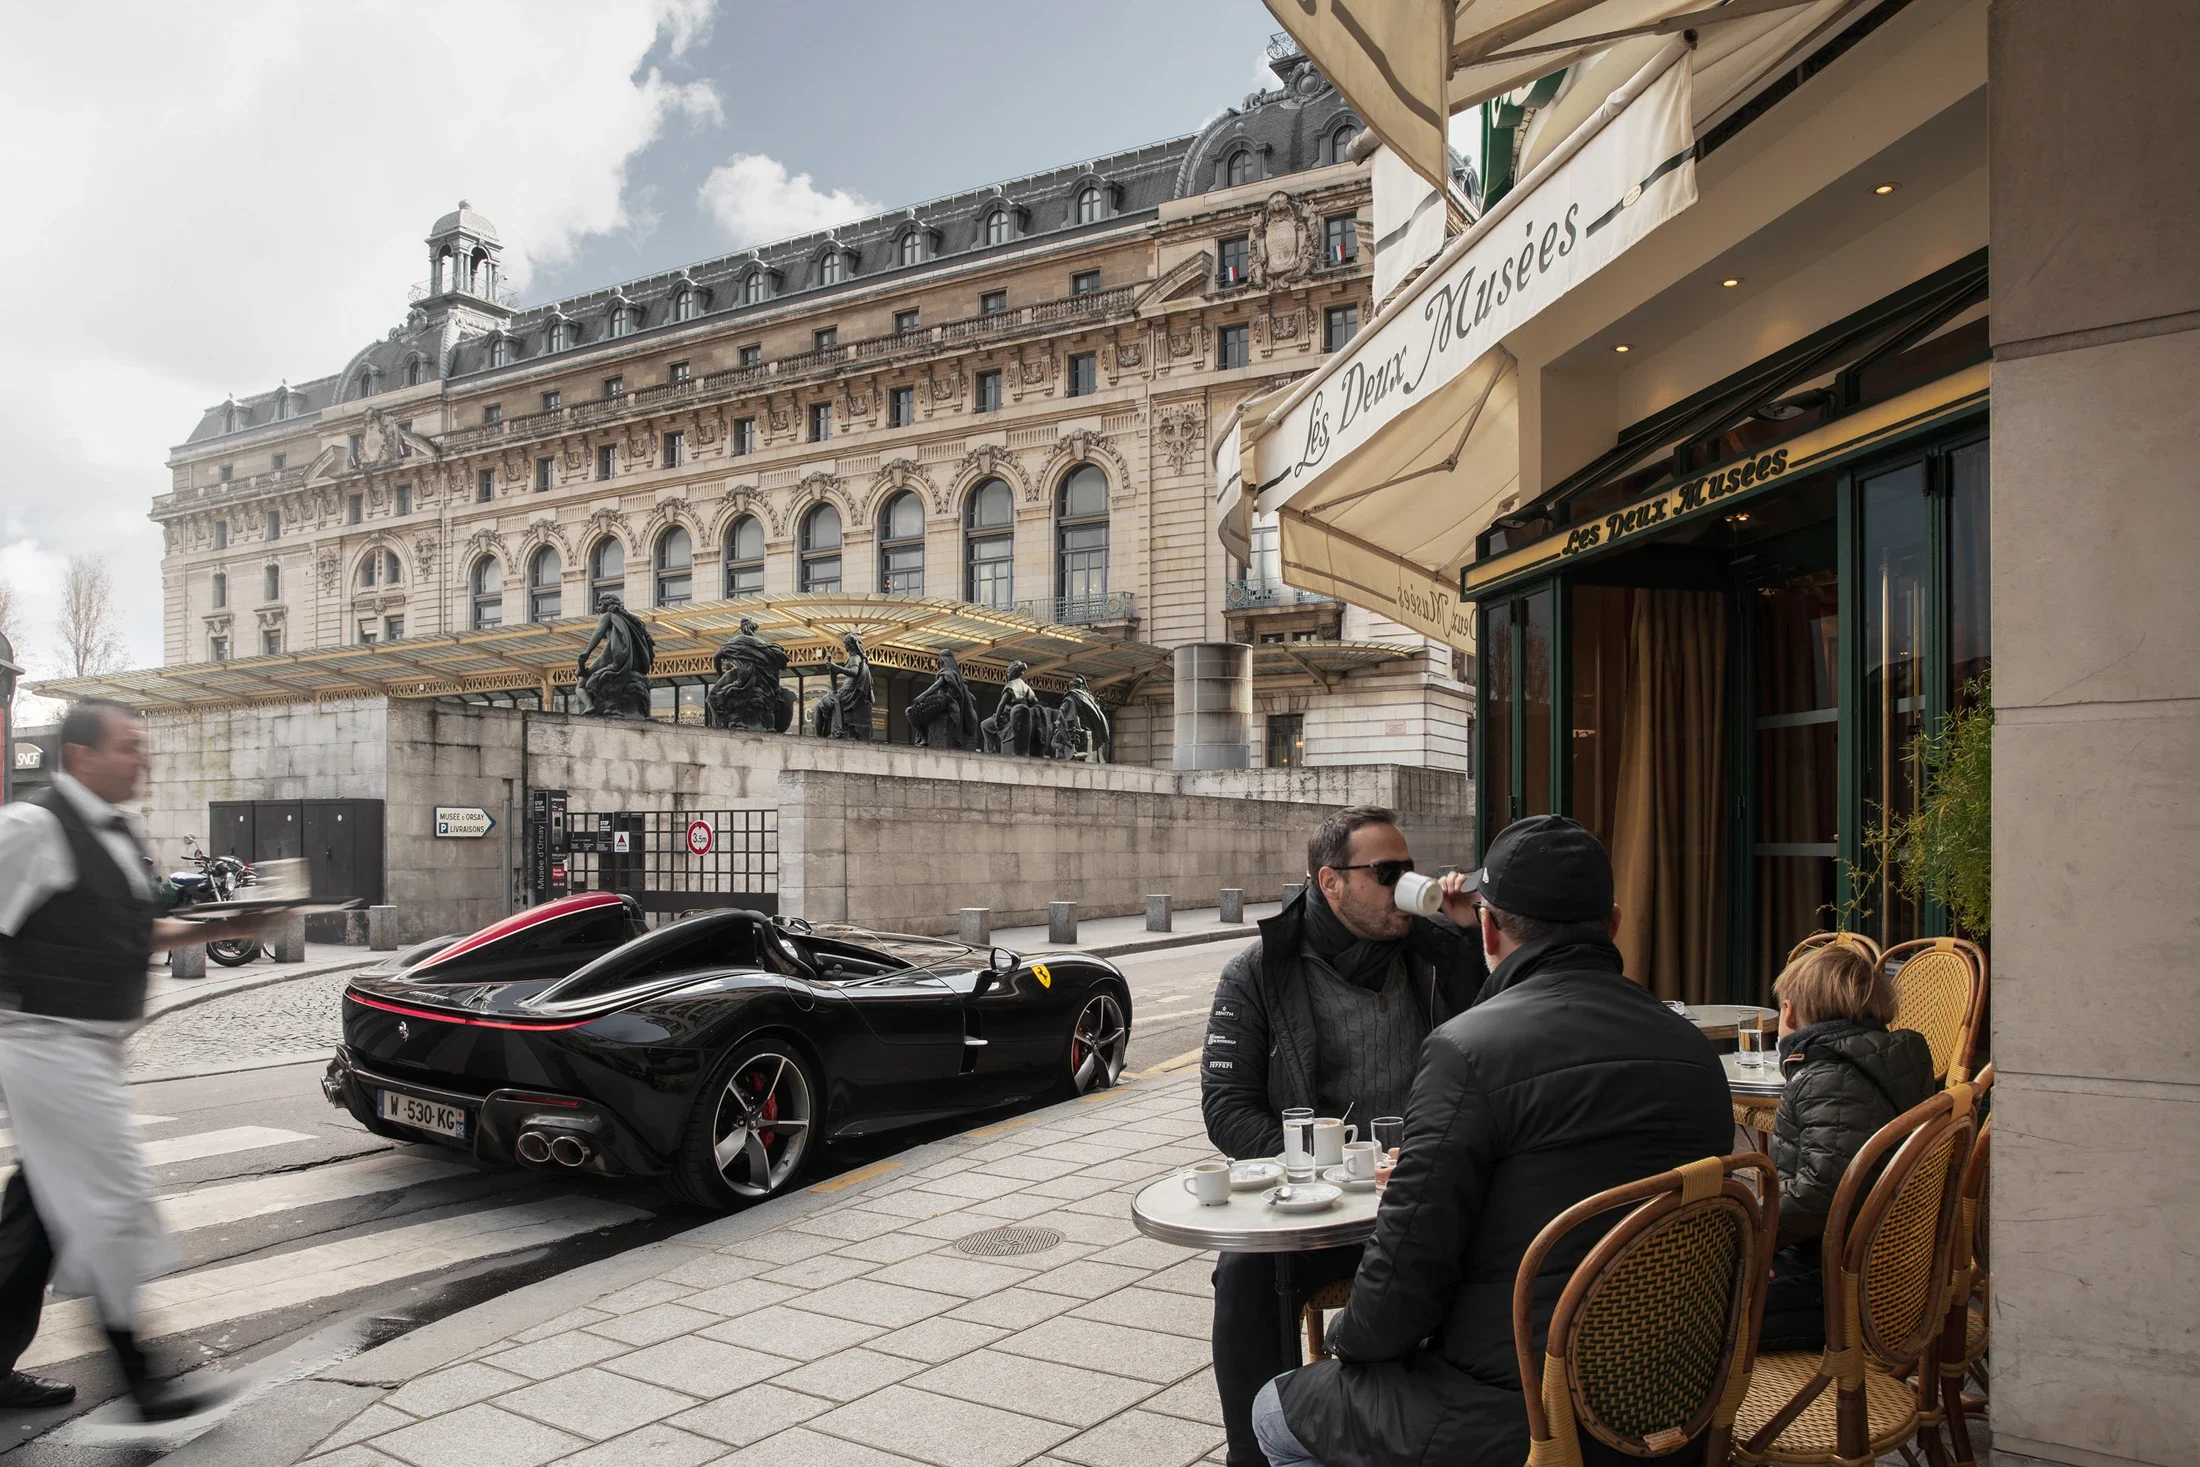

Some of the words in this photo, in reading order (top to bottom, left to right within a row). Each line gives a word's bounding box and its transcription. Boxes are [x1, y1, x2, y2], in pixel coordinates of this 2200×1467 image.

[1295, 390, 1330, 478] Les
[1337, 345, 1407, 436] Deux
[1402, 203, 1579, 395] Musées
[1562, 524, 1601, 555] Les
[1606, 497, 1668, 541] Deux
[1673, 449, 1789, 516] Musées
[17, 752, 39, 766] SNCF
[440, 813, 460, 821] MUSÉE
[440, 823, 447, 833] P
[450, 825, 485, 833] LIVRAISONS
[537, 825, 545, 857] d'Orsay
[537, 860, 545, 890] Musée
[456, 1123, 464, 1135] 92
